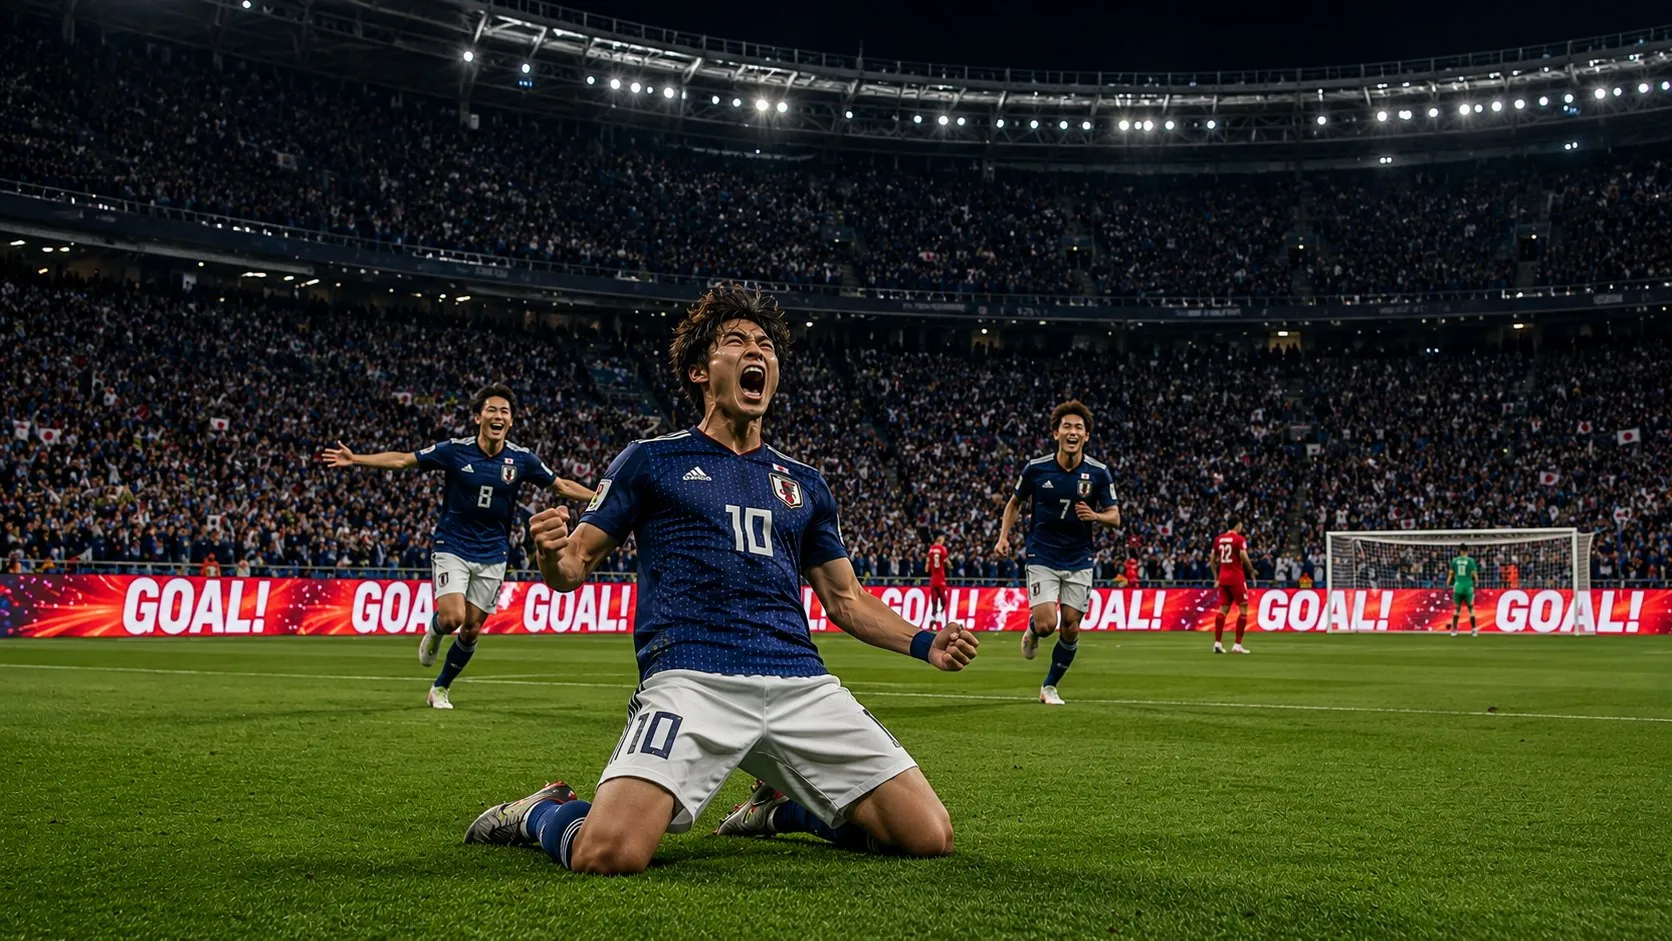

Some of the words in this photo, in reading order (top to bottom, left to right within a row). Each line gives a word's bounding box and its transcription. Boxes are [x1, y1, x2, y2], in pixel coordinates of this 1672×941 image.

[477, 485, 494, 508] 8
[1059, 498, 1071, 520] 7
[725, 504, 774, 557] 10
[122, 577, 271, 635] GOAL!
[351, 581, 434, 634] GOA
[523, 583, 631, 633] GOAL!
[1078, 589, 1166, 630] OAL!
[1257, 589, 1394, 633] GOAL!
[1495, 589, 1645, 634] GOAL!
[627, 711, 684, 760] 10
